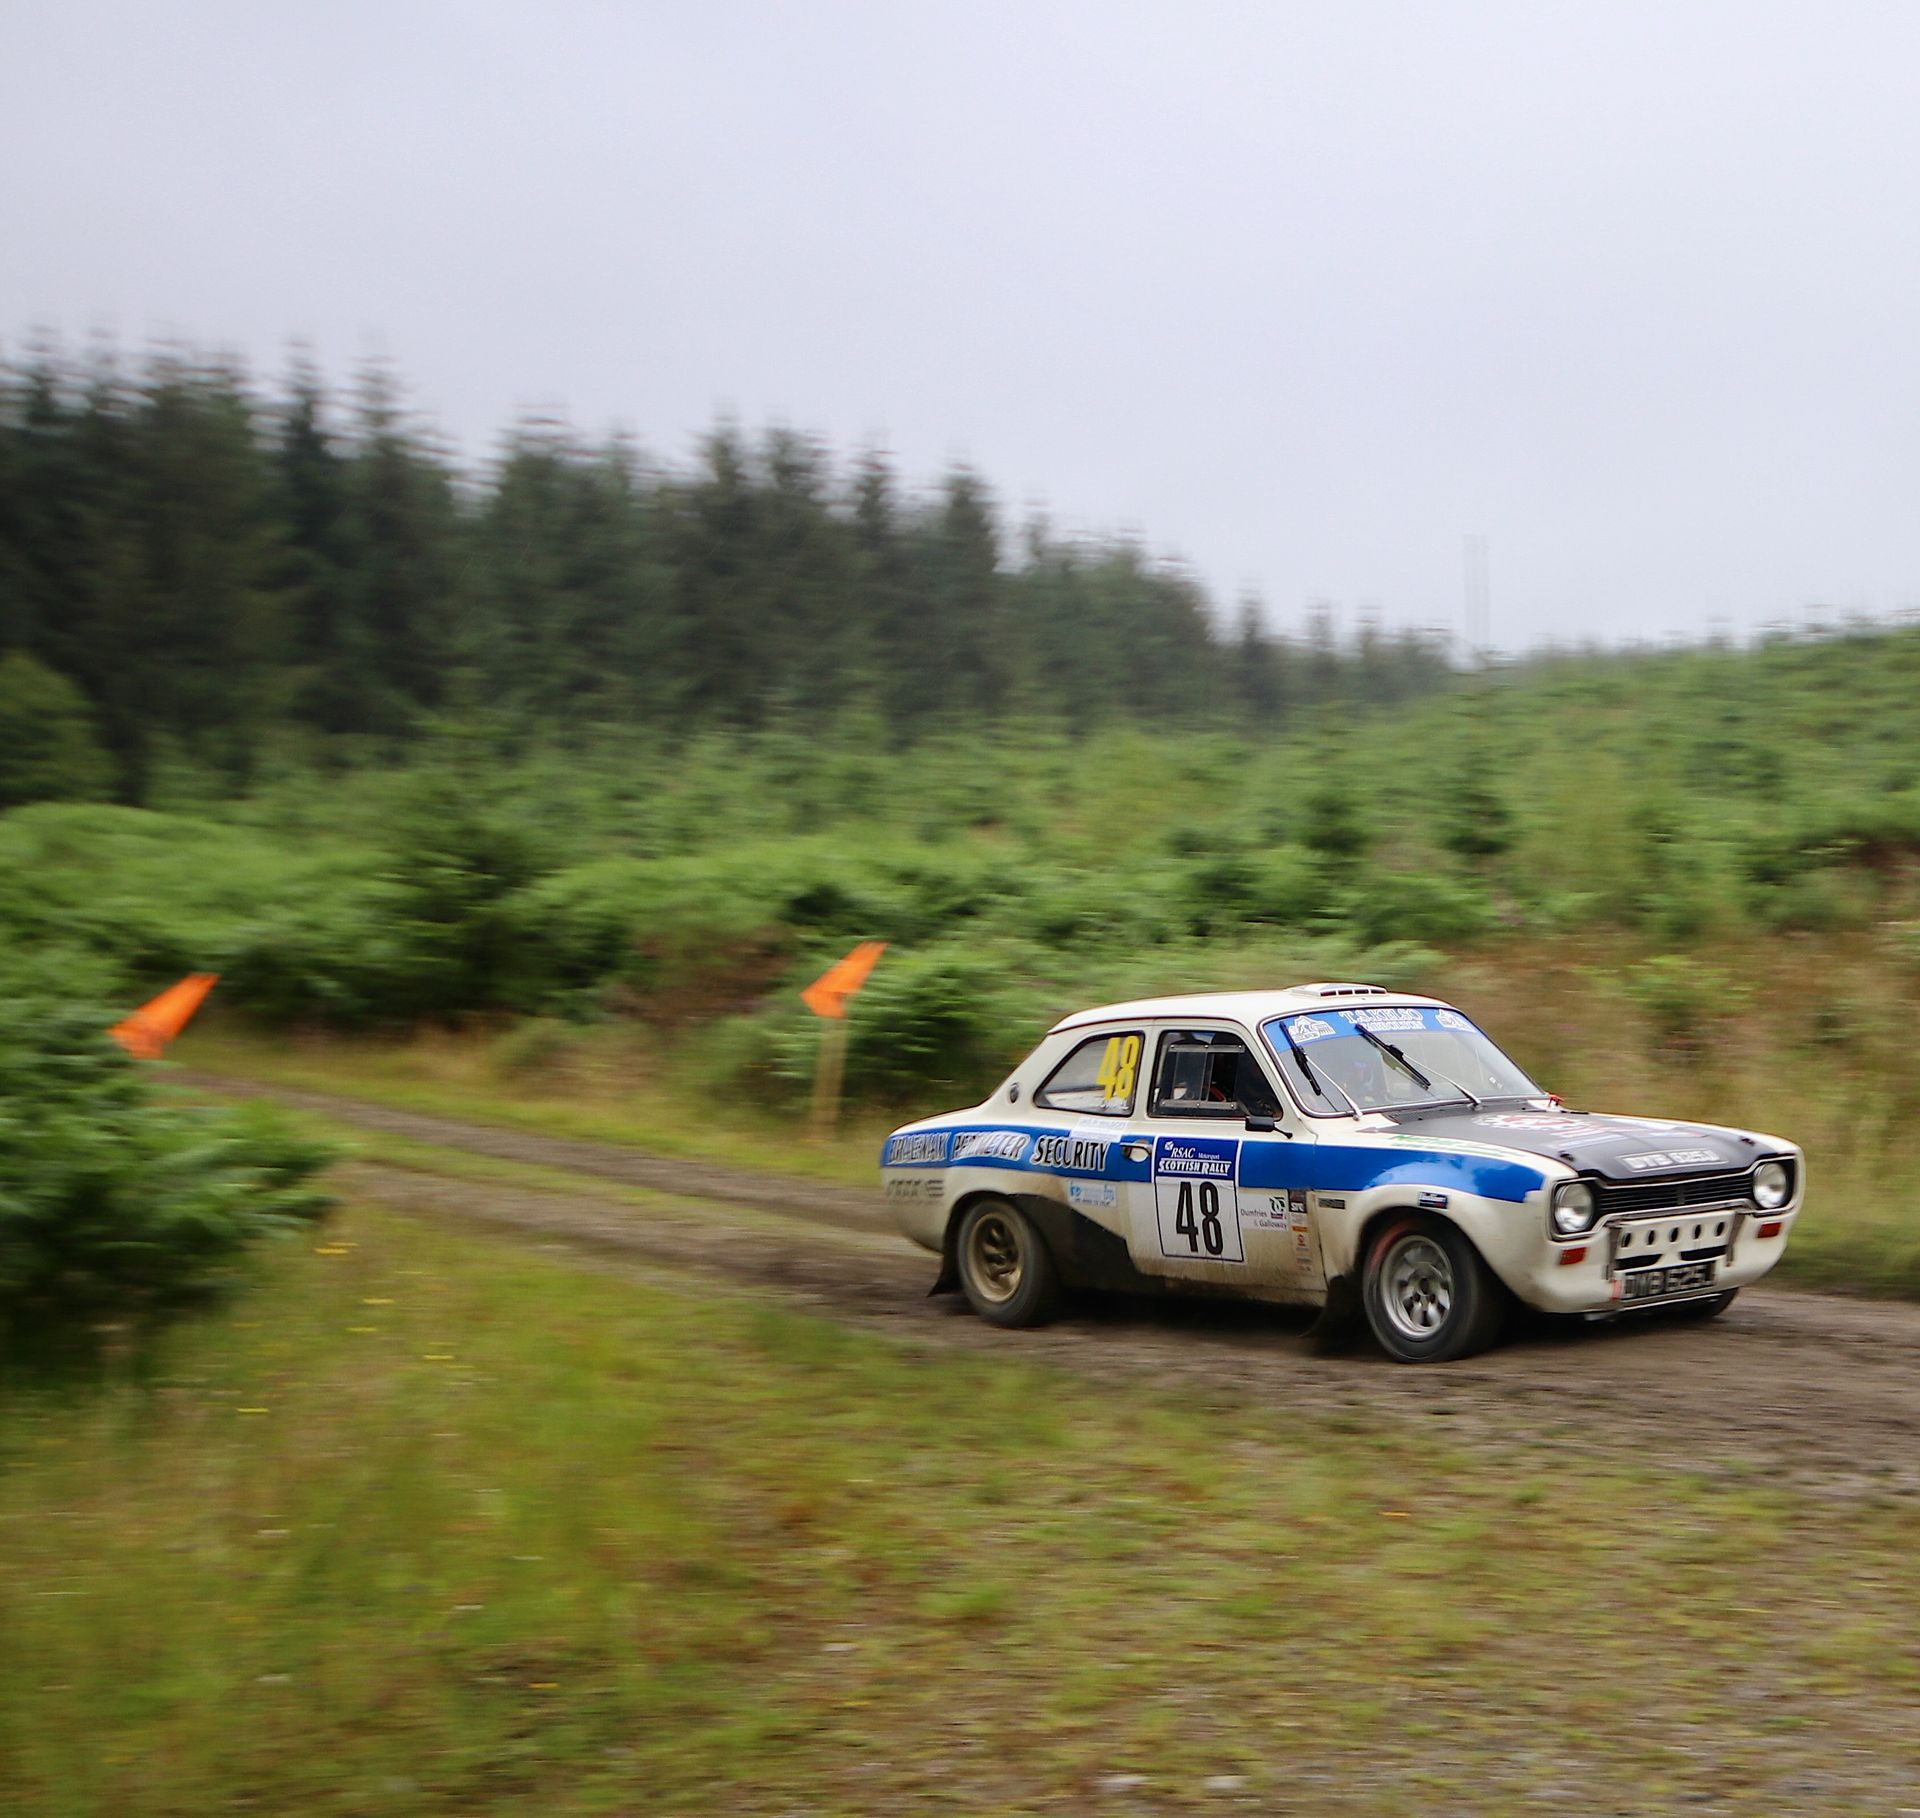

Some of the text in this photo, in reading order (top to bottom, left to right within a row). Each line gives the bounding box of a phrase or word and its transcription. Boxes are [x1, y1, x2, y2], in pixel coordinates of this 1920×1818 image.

[1096, 1035, 1140, 1101] 48
[1032, 1134, 1110, 1171] SECURITY
[1158, 1160, 1231, 1175] SCOTTISH RALLY
[1171, 1147, 1195, 1158] RSAC
[1176, 1181, 1223, 1255] 48
